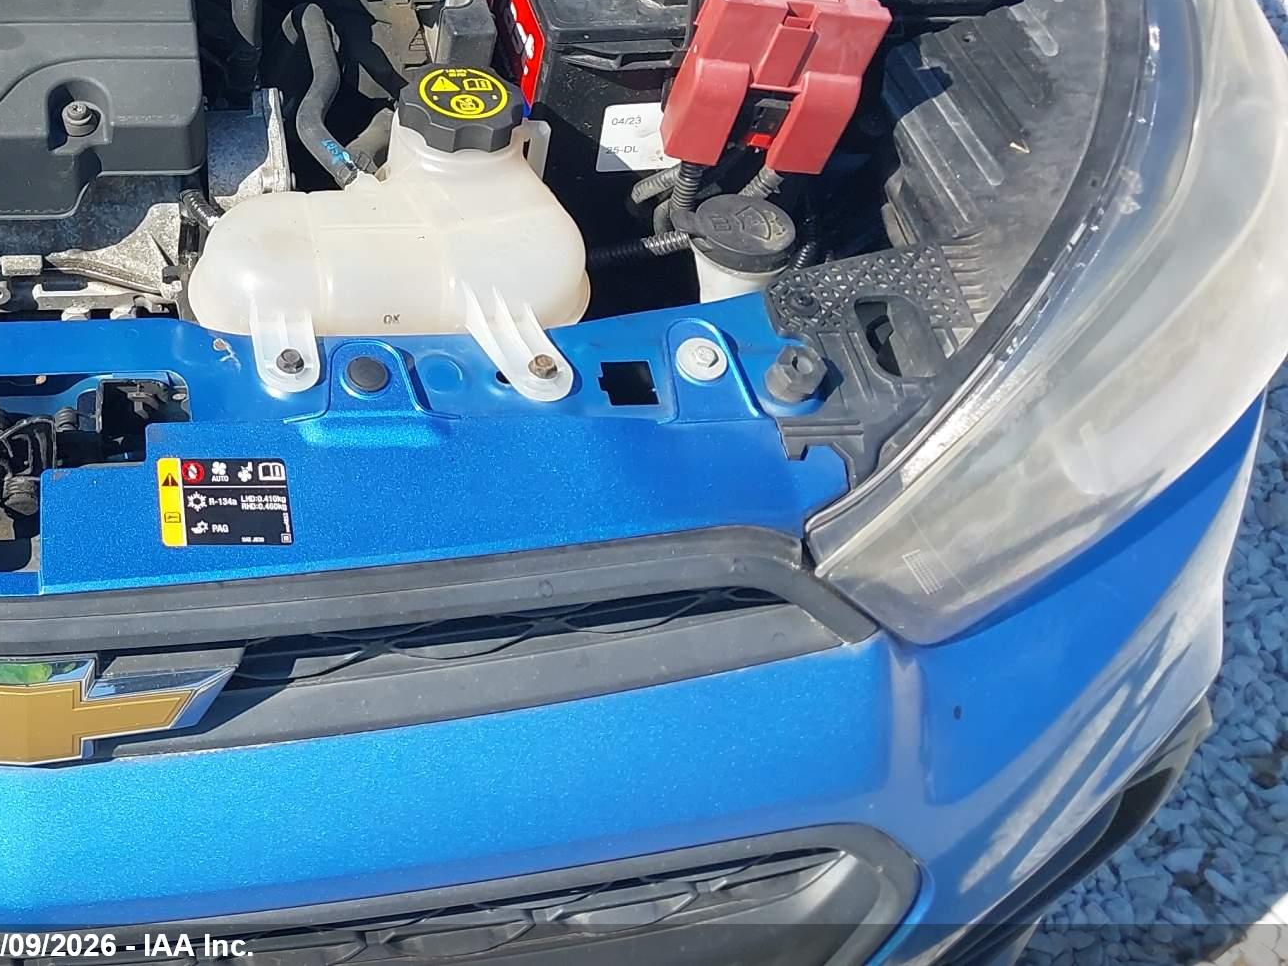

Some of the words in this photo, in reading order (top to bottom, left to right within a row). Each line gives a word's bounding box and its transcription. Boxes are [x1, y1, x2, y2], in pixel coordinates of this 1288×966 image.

[612, 117, 642, 126] 04/23
[208, 497, 237, 506] R-134a
[211, 524, 229, 533] PAG
